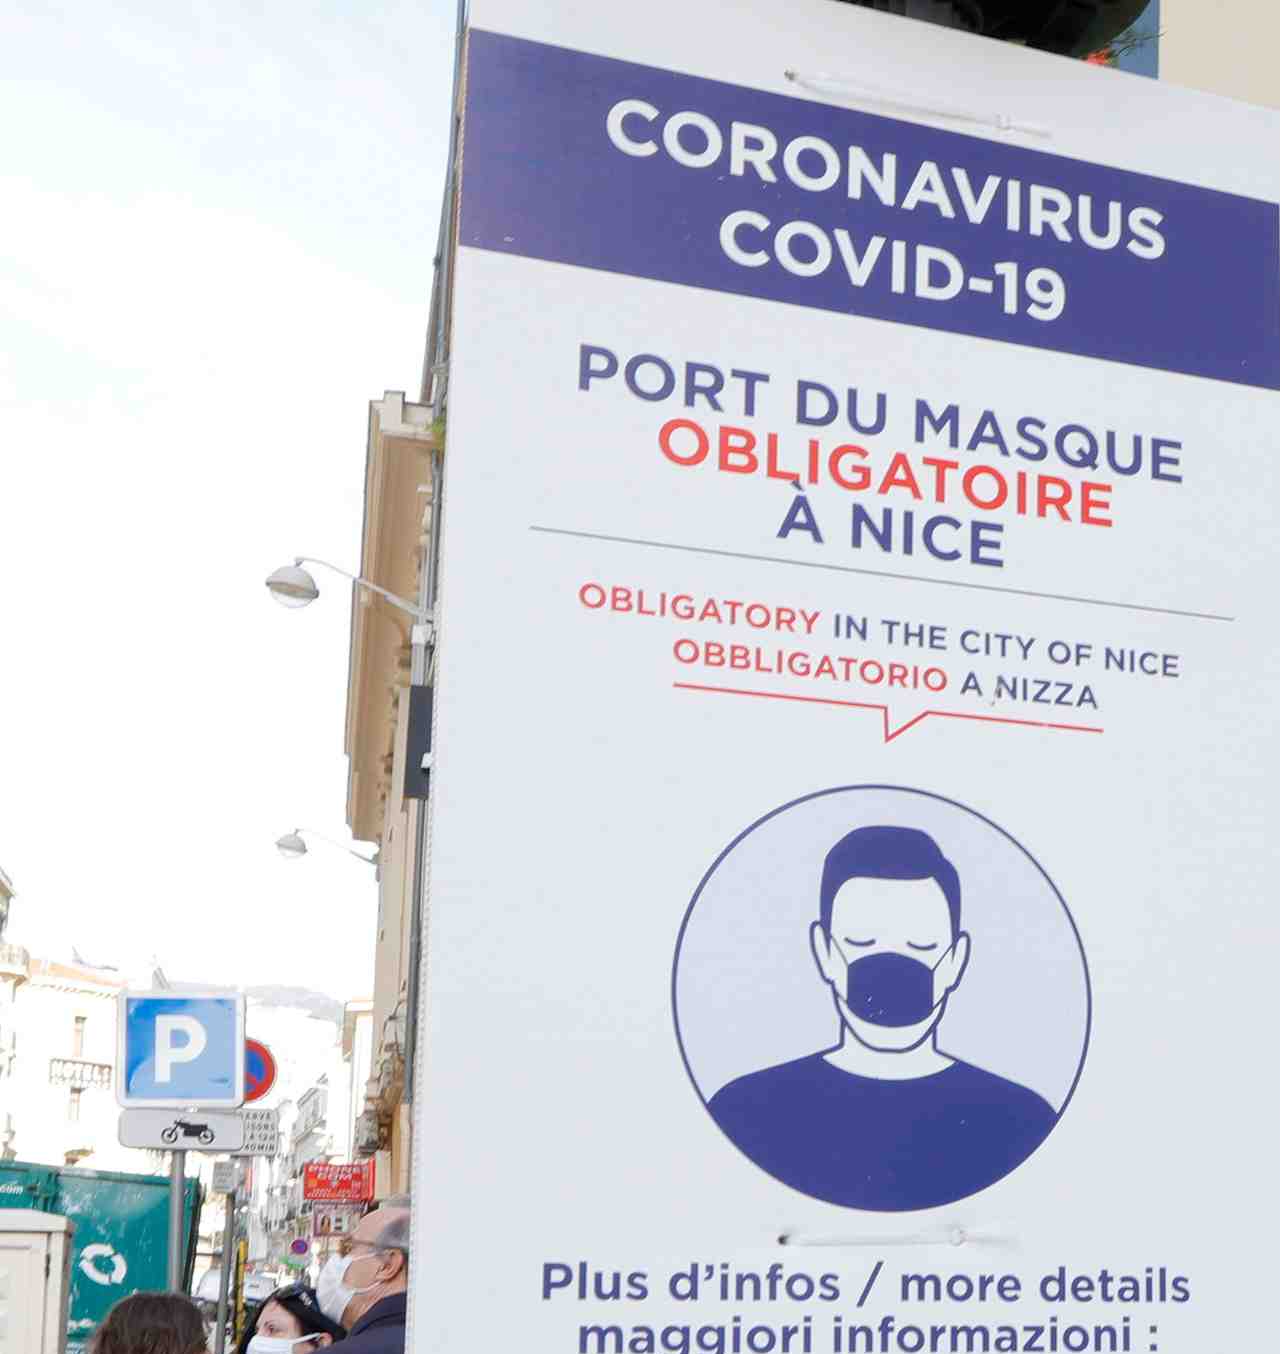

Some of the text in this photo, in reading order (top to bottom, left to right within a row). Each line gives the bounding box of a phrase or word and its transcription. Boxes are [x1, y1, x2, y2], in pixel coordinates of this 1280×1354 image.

[606, 99, 1166, 260] CORONAVIRUS
[719, 210, 1066, 321] COVID-19
[579, 344, 1183, 483] PORT DU MASQUE
[658, 418, 1113, 528] OBLIGATOIRE
[776, 483, 1005, 568] À NICE
[579, 583, 1179, 678] OBLIGATORY IN THE CITY OF NICE
[673, 639, 1097, 709] OBBLIGATORIO A NIZZA
[154, 1013, 208, 1084] P
[542, 1261, 649, 1301] Plus
[668, 1261, 840, 1302] d'infos
[901, 1274, 1022, 1303] more
[1039, 1266, 1190, 1303] details
[833, 1315, 1131, 1354] informazioni
